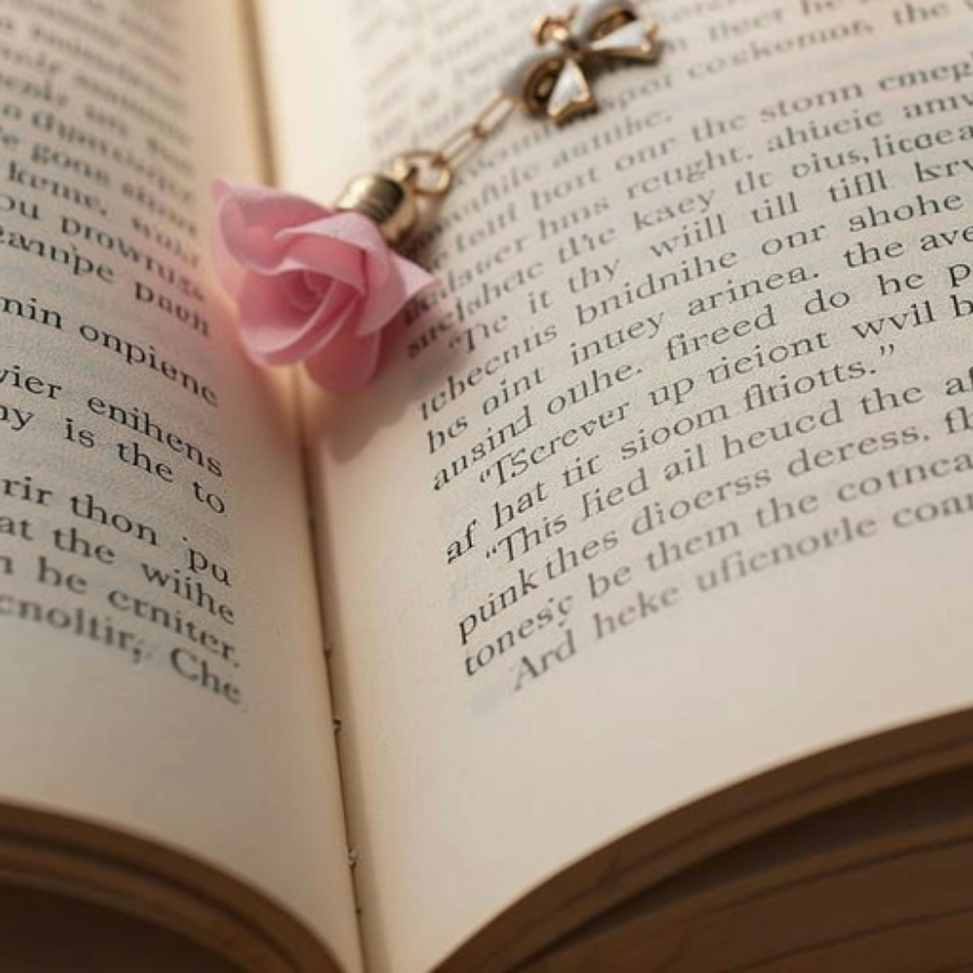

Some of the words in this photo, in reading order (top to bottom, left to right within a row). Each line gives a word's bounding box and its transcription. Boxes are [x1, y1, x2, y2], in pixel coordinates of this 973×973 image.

[843, 240, 905, 268] the
[805, 289, 850, 315] do
[649, 377, 694, 406] up
[860, 387, 925, 415] the
[64, 418, 96, 448] is
[118, 442, 174, 483] the
[193, 481, 226, 514] to
[71, 494, 158, 546] thon
[494, 481, 548, 530] hat
[53, 527, 116, 565] the
[588, 565, 632, 599] be
[647, 520, 740, 572] them
[756, 494, 819, 528] the
